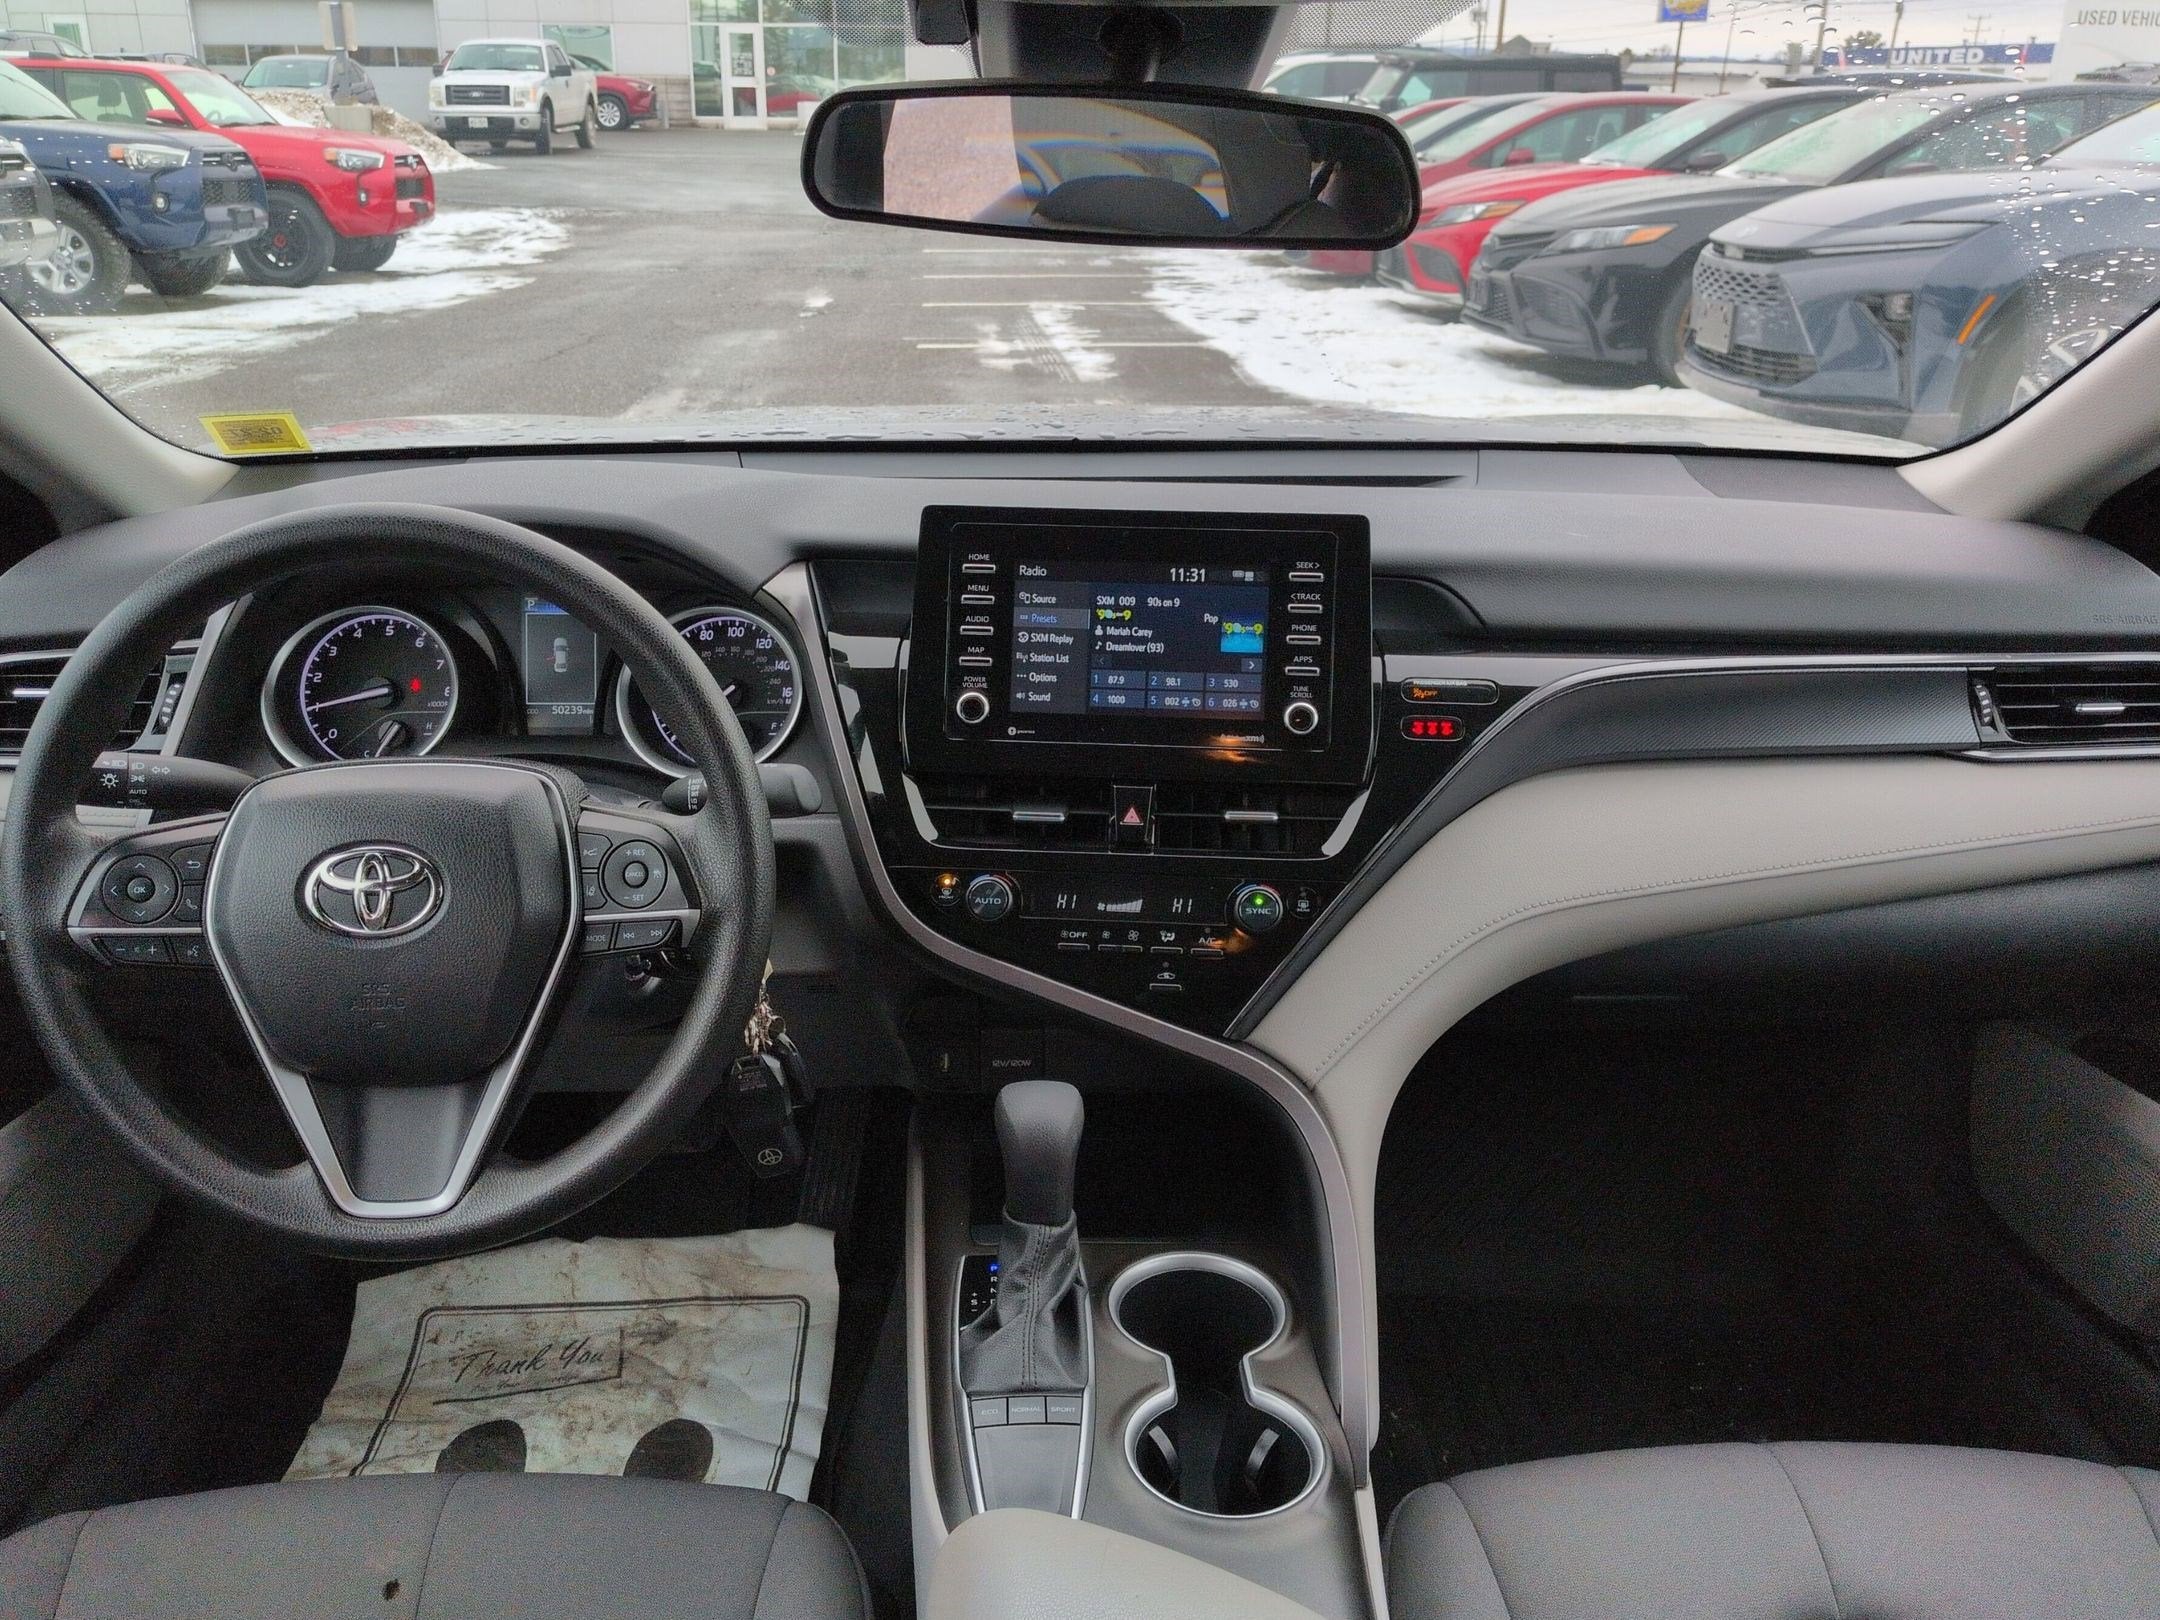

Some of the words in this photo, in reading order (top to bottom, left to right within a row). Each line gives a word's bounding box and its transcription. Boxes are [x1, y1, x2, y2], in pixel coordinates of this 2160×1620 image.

[2079, 9, 2117, 25] USED
[1891, 48, 1984, 65] UNITED
[1019, 565, 1047, 576] Radio
[1170, 567, 1206, 582] 11:31
[967, 584, 989, 592] MENU
[1032, 593, 1057, 604] Source
[1096, 596, 1114, 606] SXM
[1119, 596, 1136, 606] 009
[1147, 597, 1162, 607] 90s
[1174, 597, 1180, 607] 9
[527, 600, 535, 609] P
[965, 615, 989, 623] AUDIO
[1031, 613, 1058, 623] Presets
[1204, 613, 1218, 625] Pop
[353, 628, 362, 638] 4
[385, 625, 394, 636] 5
[728, 626, 745, 638] 100
[1106, 626, 1131, 636] Mariah
[1132, 627, 1153, 638] Carey
[1291, 624, 1318, 632] PHONE
[700, 630, 714, 641] 80
[1030, 633, 1048, 643] SXM
[1049, 633, 1074, 645] Replay
[415, 637, 424, 648] 6
[756, 638, 772, 649] 120
[1106, 641, 1146, 652] Dreamlover
[1147, 642, 1165, 654] (93)
[329, 646, 337, 657] 3
[1029, 652, 1055, 663] Station
[1056, 653, 1070, 663] List
[436, 659, 444, 670] 7
[313, 672, 322, 683] 2
[1029, 672, 1057, 684] Options
[1094, 674, 1099, 684] 1
[1107, 675, 1125, 685] 87.9
[1151, 676, 1158, 686] 2
[1165, 677, 1181, 687] 98.1
[1208, 678, 1215, 687] 3
[1223, 679, 1239, 689] 530
[1028, 691, 1051, 702] Sound
[1092, 694, 1099, 704] 4
[1107, 695, 1126, 705] 1000
[1151, 695, 1157, 705] 5
[1208, 697, 1215, 707] 6
[552, 705, 583, 715] 50239
[328, 728, 338, 739] 0
[133, 885, 146, 894] OK
[974, 897, 1002, 905] AUTO
[1245, 907, 1273, 915] SYNC
[586, 934, 606, 942] MODE
[1198, 936, 1216, 944] A/C
[449, 1344, 554, 1383] Thank
[559, 1336, 603, 1369] You
[981, 1408, 999, 1416] ECO
[1011, 1406, 1042, 1414] NORMAL
[1050, 1406, 1076, 1414] SPORT
